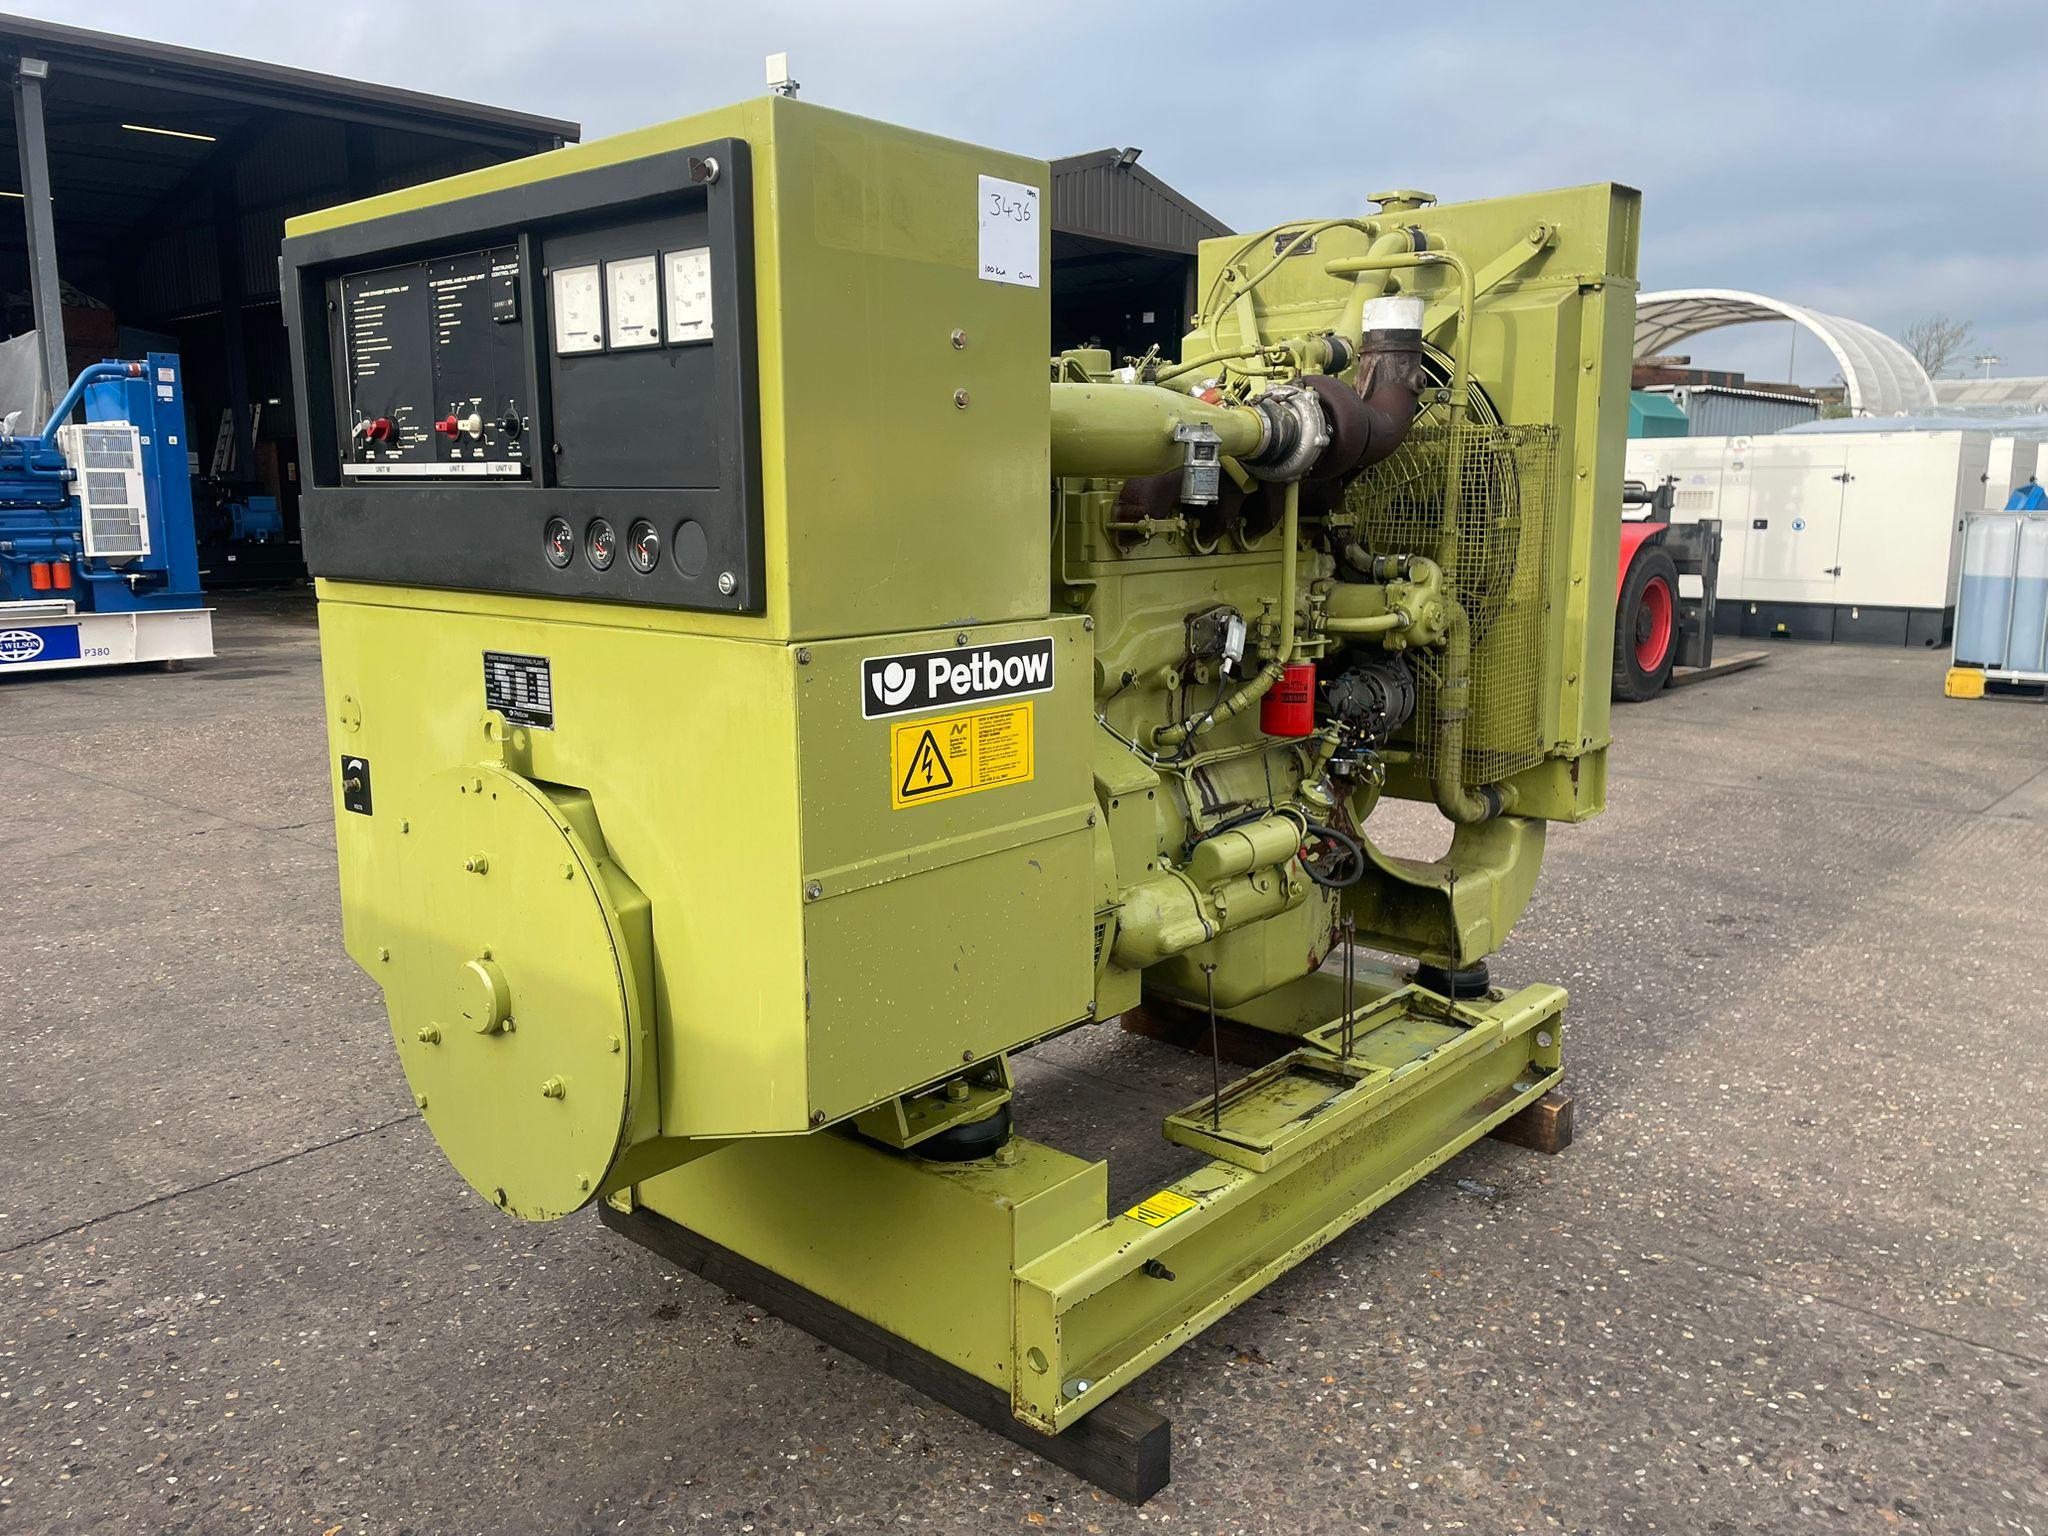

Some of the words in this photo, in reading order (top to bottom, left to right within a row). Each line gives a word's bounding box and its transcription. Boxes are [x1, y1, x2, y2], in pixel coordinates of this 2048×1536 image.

[990, 193, 1031, 222] 3436
[4, 640, 39, 649] WILSON
[84, 647, 110, 657] P380
[928, 651, 1049, 699] Petbow
